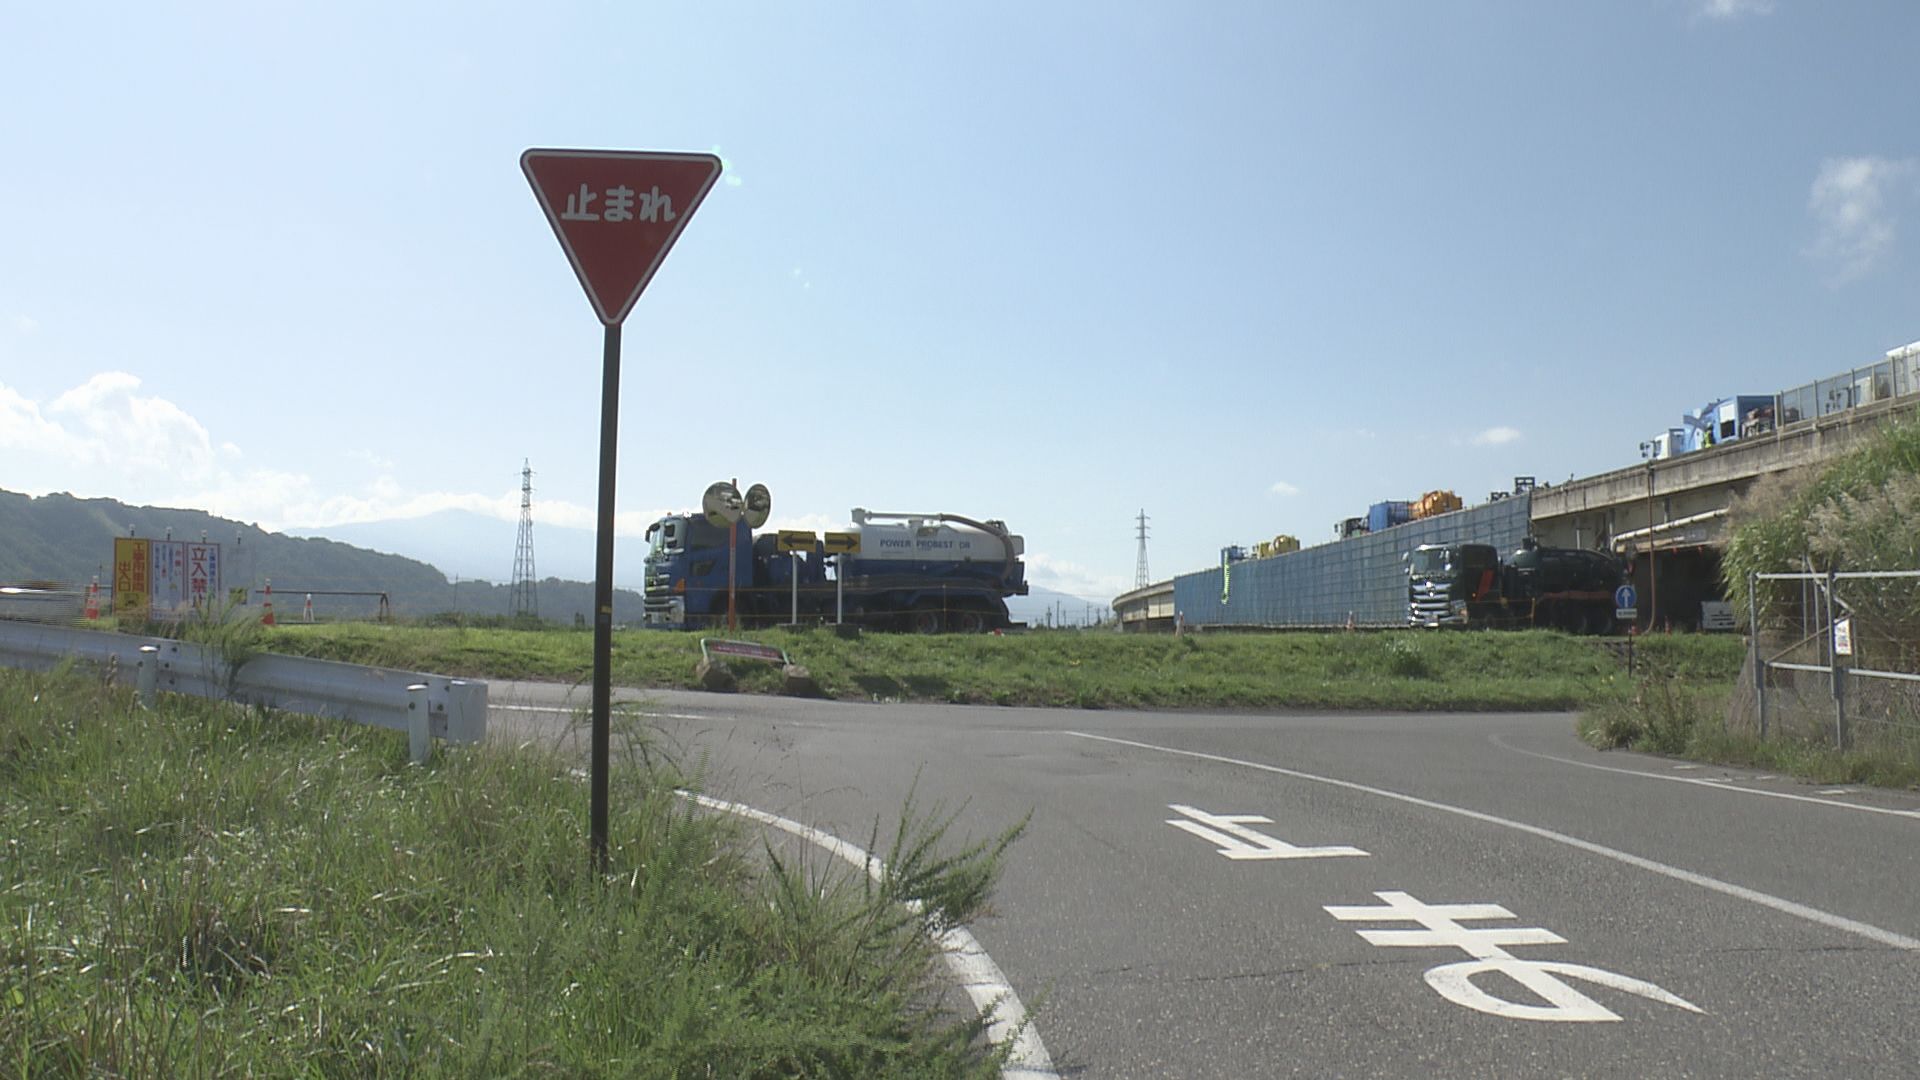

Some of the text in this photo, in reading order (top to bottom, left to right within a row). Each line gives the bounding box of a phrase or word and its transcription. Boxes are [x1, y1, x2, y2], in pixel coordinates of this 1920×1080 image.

[560, 183, 676, 223] 止まれ
[880, 539, 911, 548] POWER
